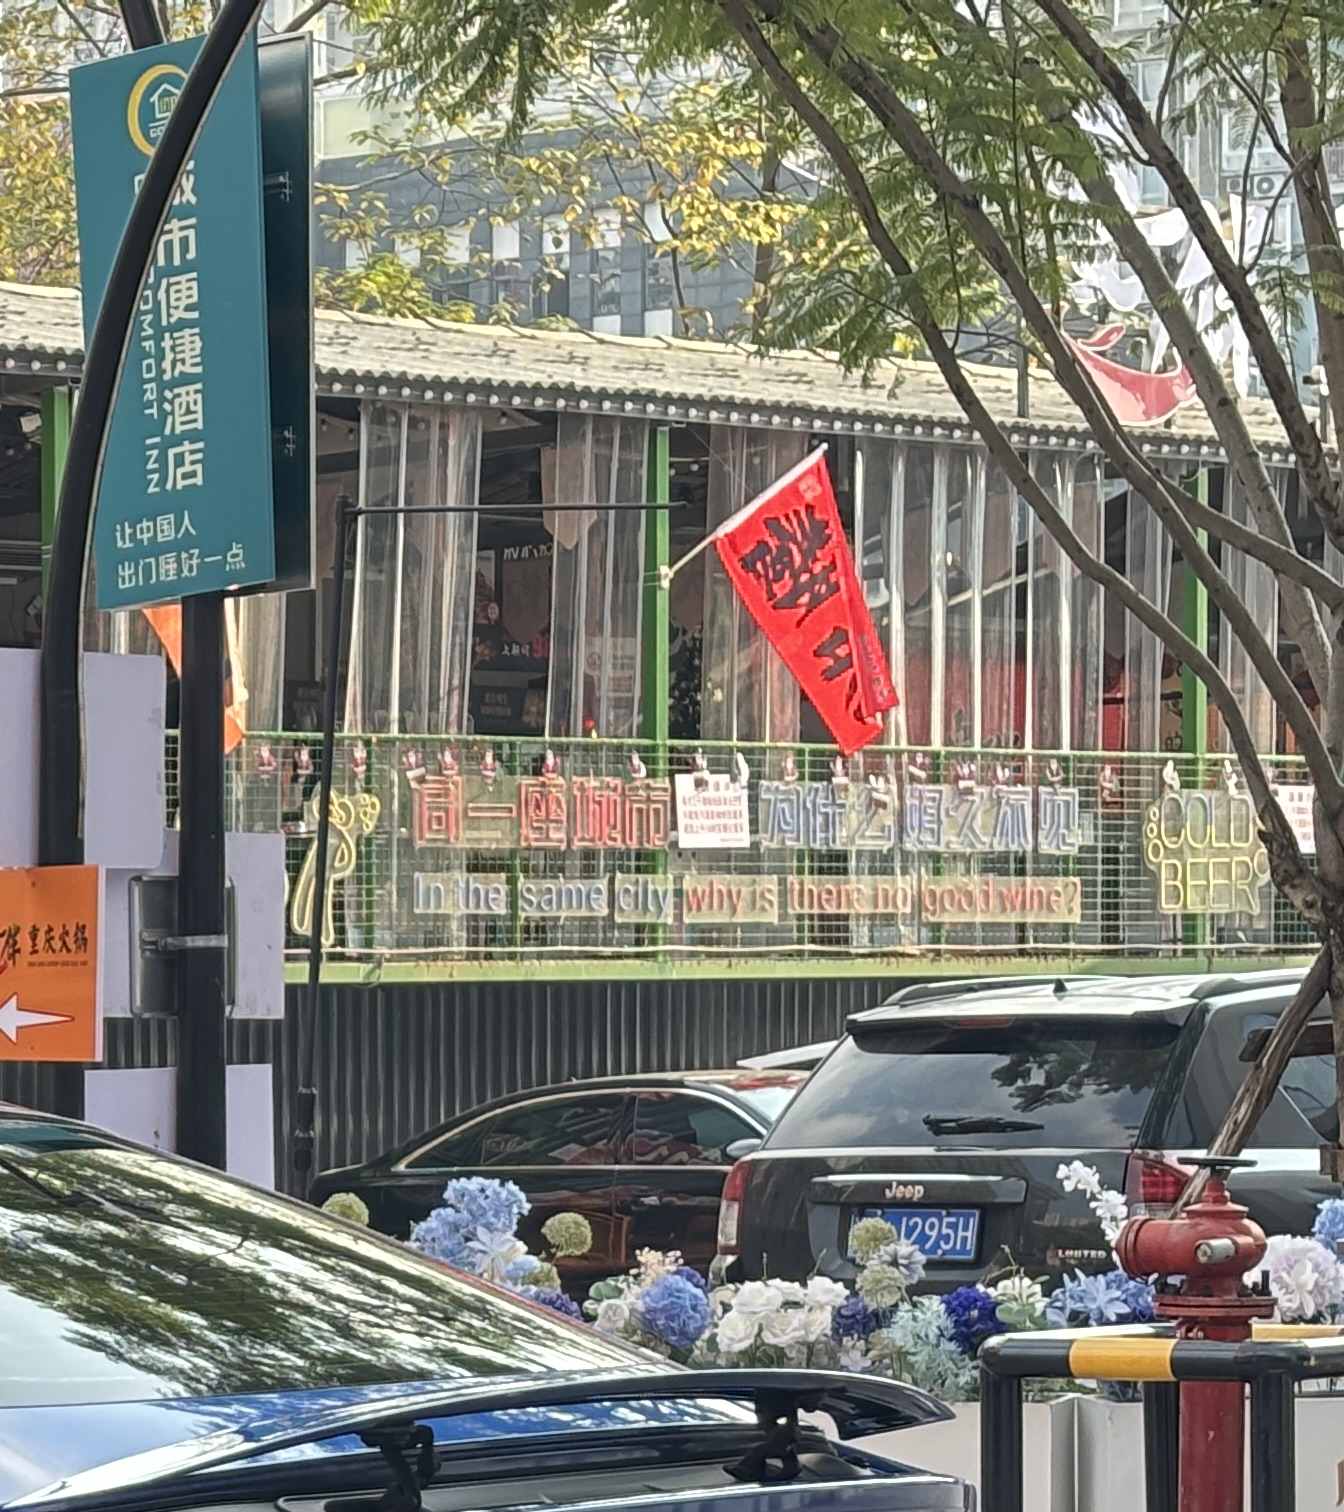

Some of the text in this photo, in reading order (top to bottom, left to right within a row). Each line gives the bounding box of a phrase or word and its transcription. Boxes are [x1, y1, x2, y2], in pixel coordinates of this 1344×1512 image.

[145, 436, 161, 494] INN
[115, 509, 197, 549] 让中国人
[118, 541, 246, 590] 出门睡好一点
[414, 776, 671, 849] 同一座城市
[1161, 793, 1254, 848] COLD
[416, 872, 445, 912] In
[455, 872, 507, 912] the
[520, 881, 607, 912] same
[619, 876, 673, 920] city
[686, 878, 743, 916] why
[753, 879, 776, 911] is
[792, 879, 867, 911] there
[876, 886, 911, 911] no
[922, 877, 994, 918] good
[1161, 856, 1259, 912] BEER
[28, 922, 89, 955] 重庆火锅
[885, 1181, 925, 1201] Jeep
